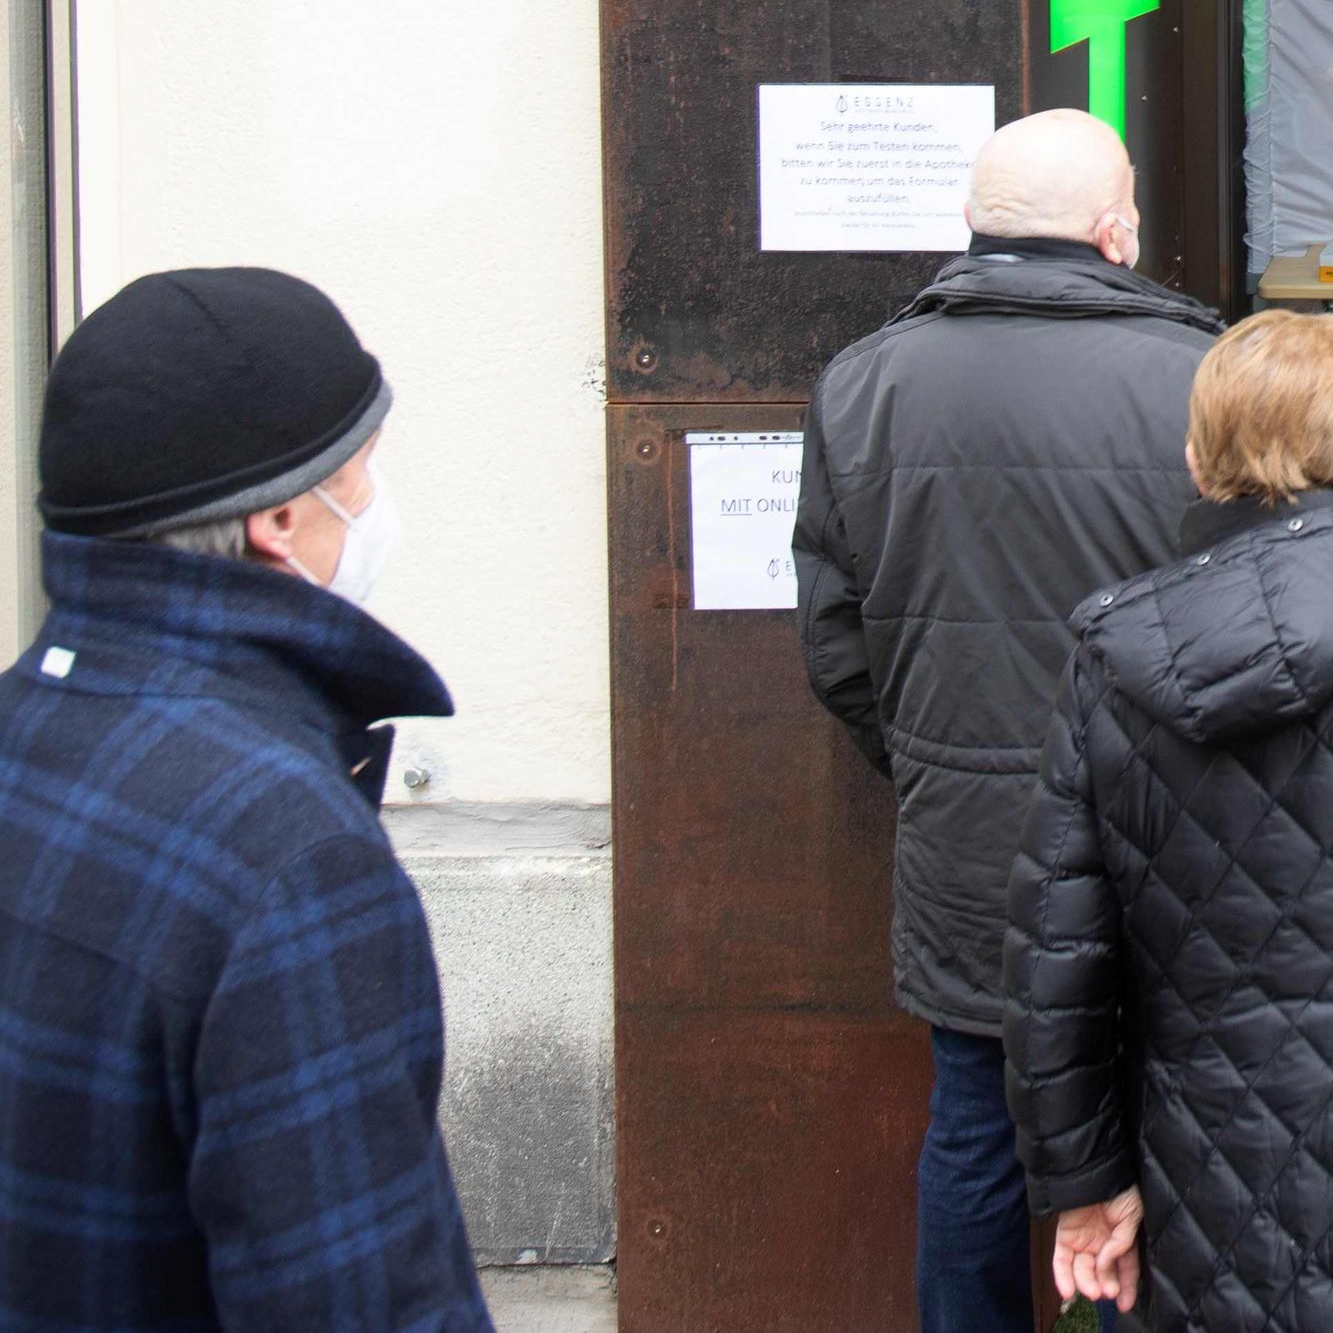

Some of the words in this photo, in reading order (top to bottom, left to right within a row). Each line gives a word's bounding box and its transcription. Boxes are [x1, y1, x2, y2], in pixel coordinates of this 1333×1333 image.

[854, 96, 914, 107] ESSENZ
[874, 141, 909, 151] Testen
[721, 499, 752, 512] MIT
